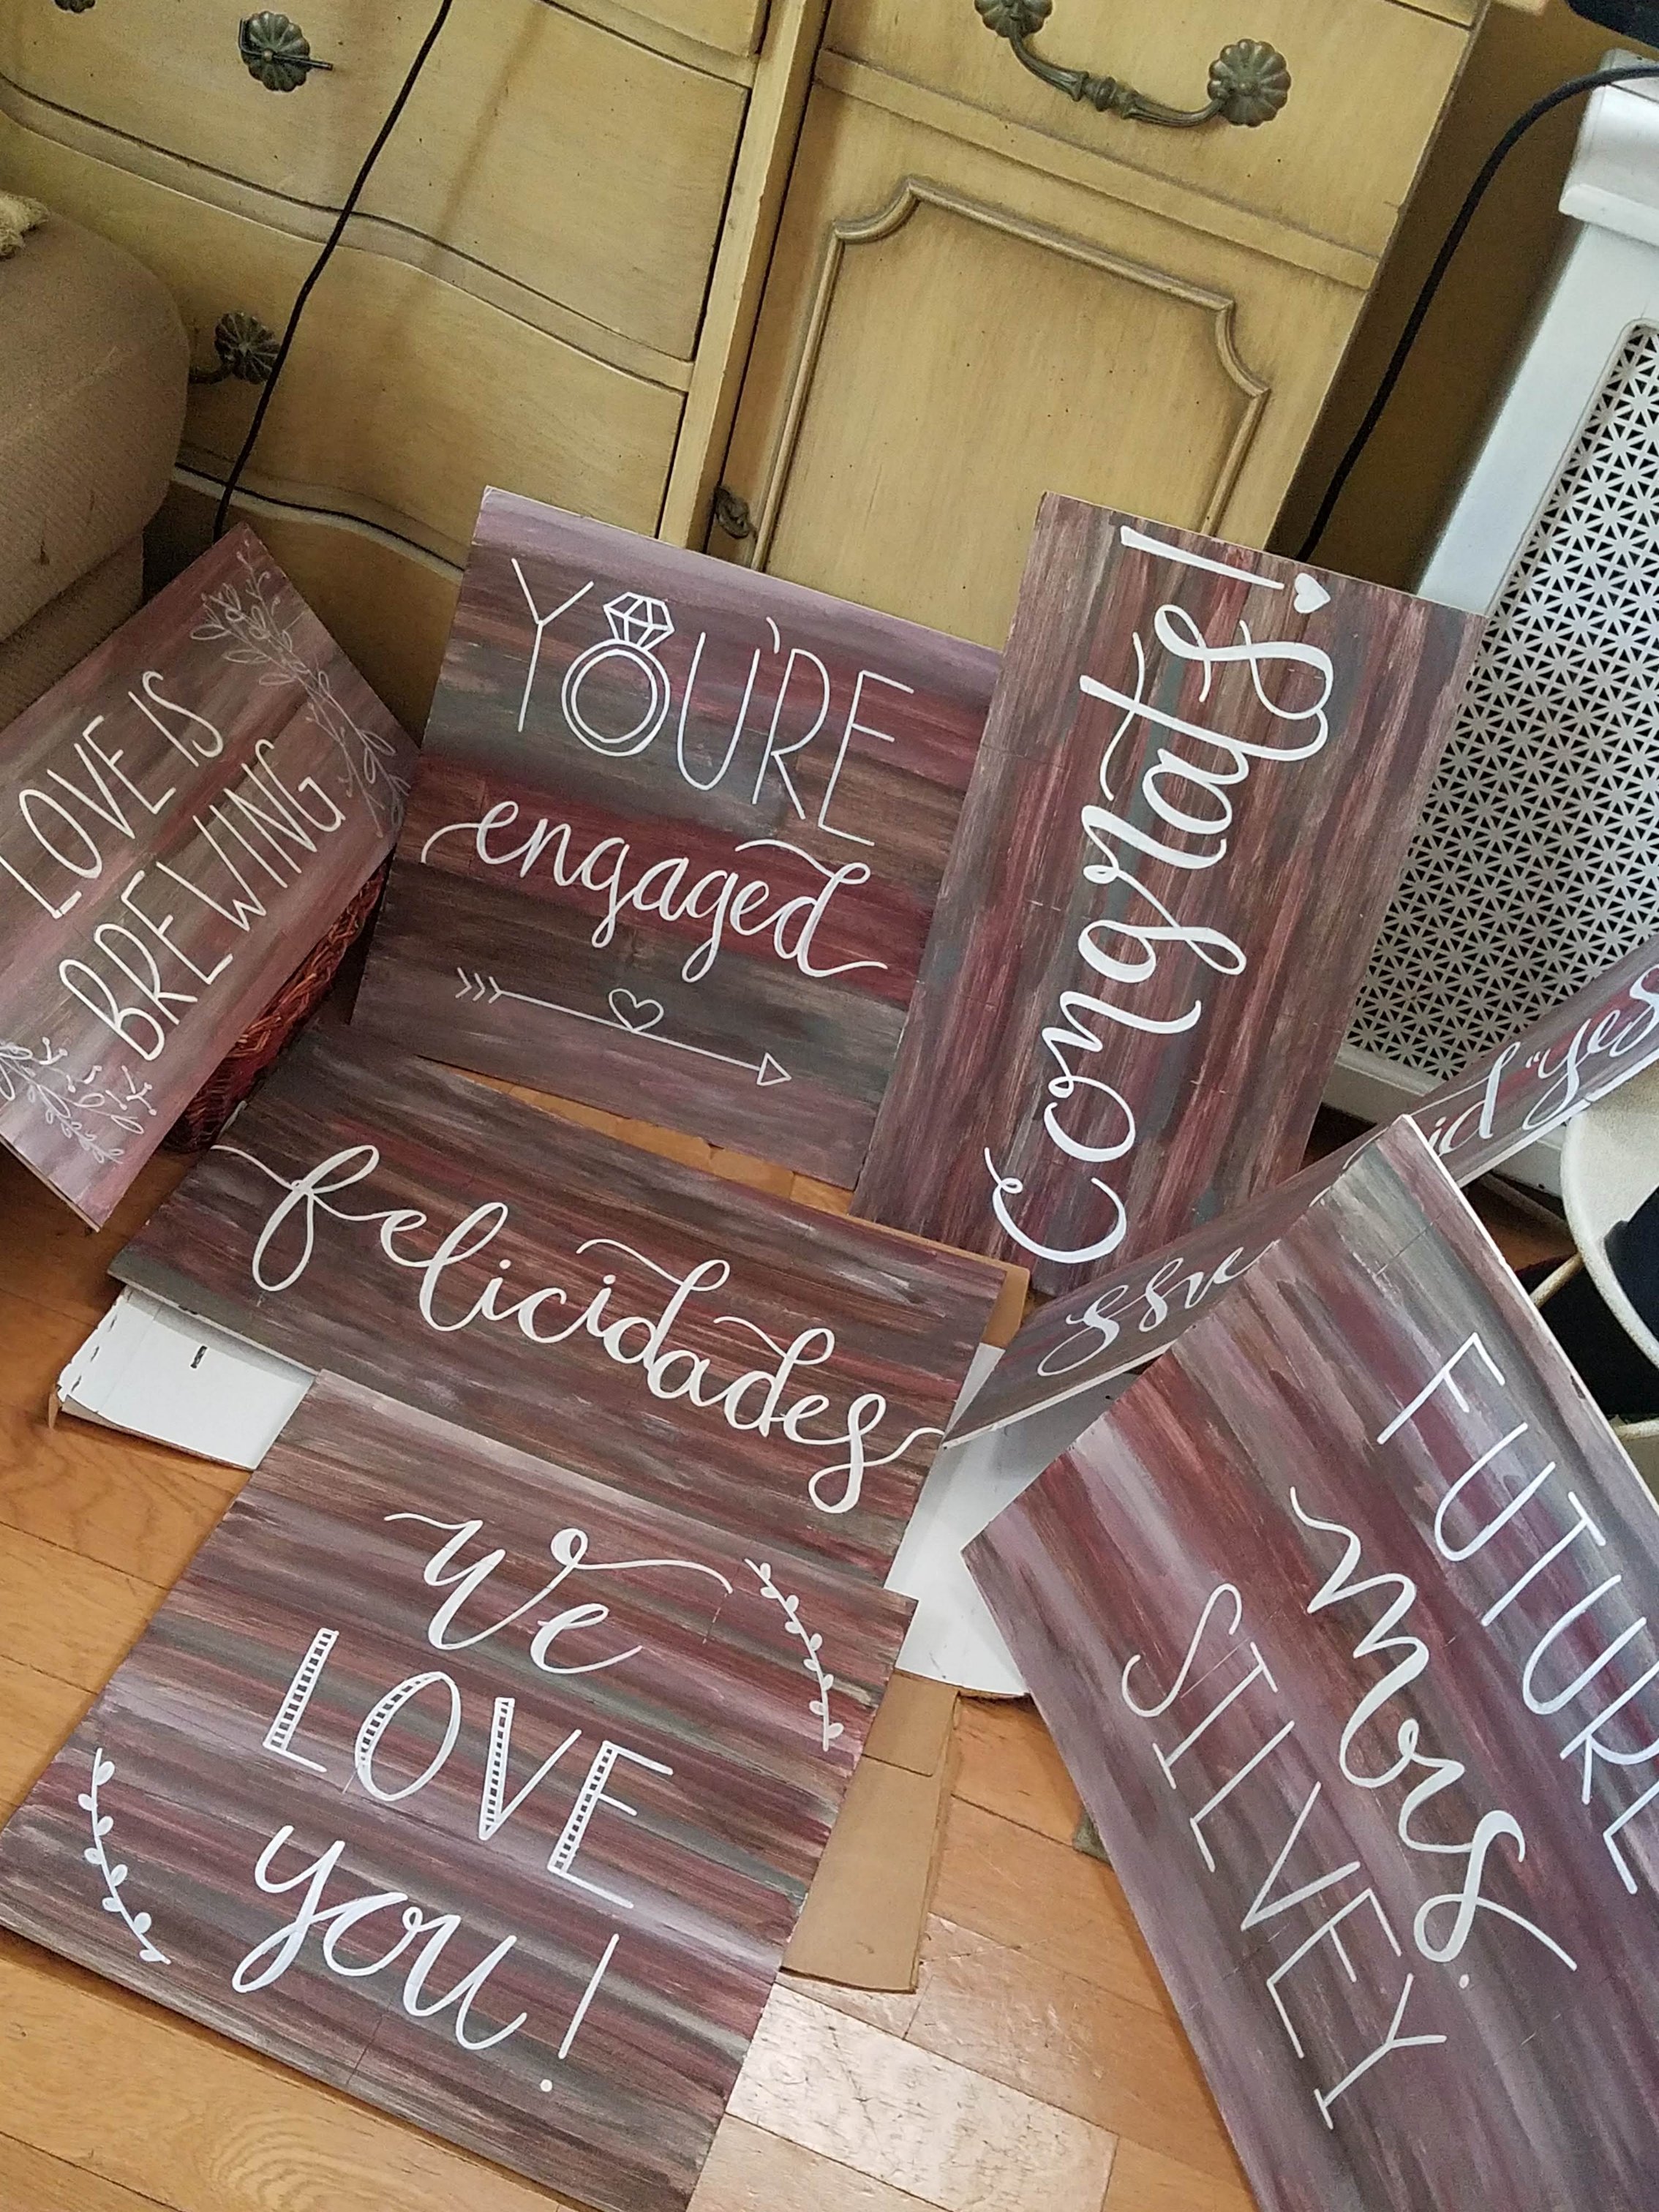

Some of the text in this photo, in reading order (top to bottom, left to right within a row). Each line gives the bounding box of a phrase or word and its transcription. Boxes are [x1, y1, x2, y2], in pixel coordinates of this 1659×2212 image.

[0, 670, 224, 919] LOVE IS
[59, 739, 346, 1061] BREWING
[421, 800, 888, 983] engaged
[263, 1628, 673, 1908] LOVE
[1121, 1583, 1448, 2130] SILVEY
